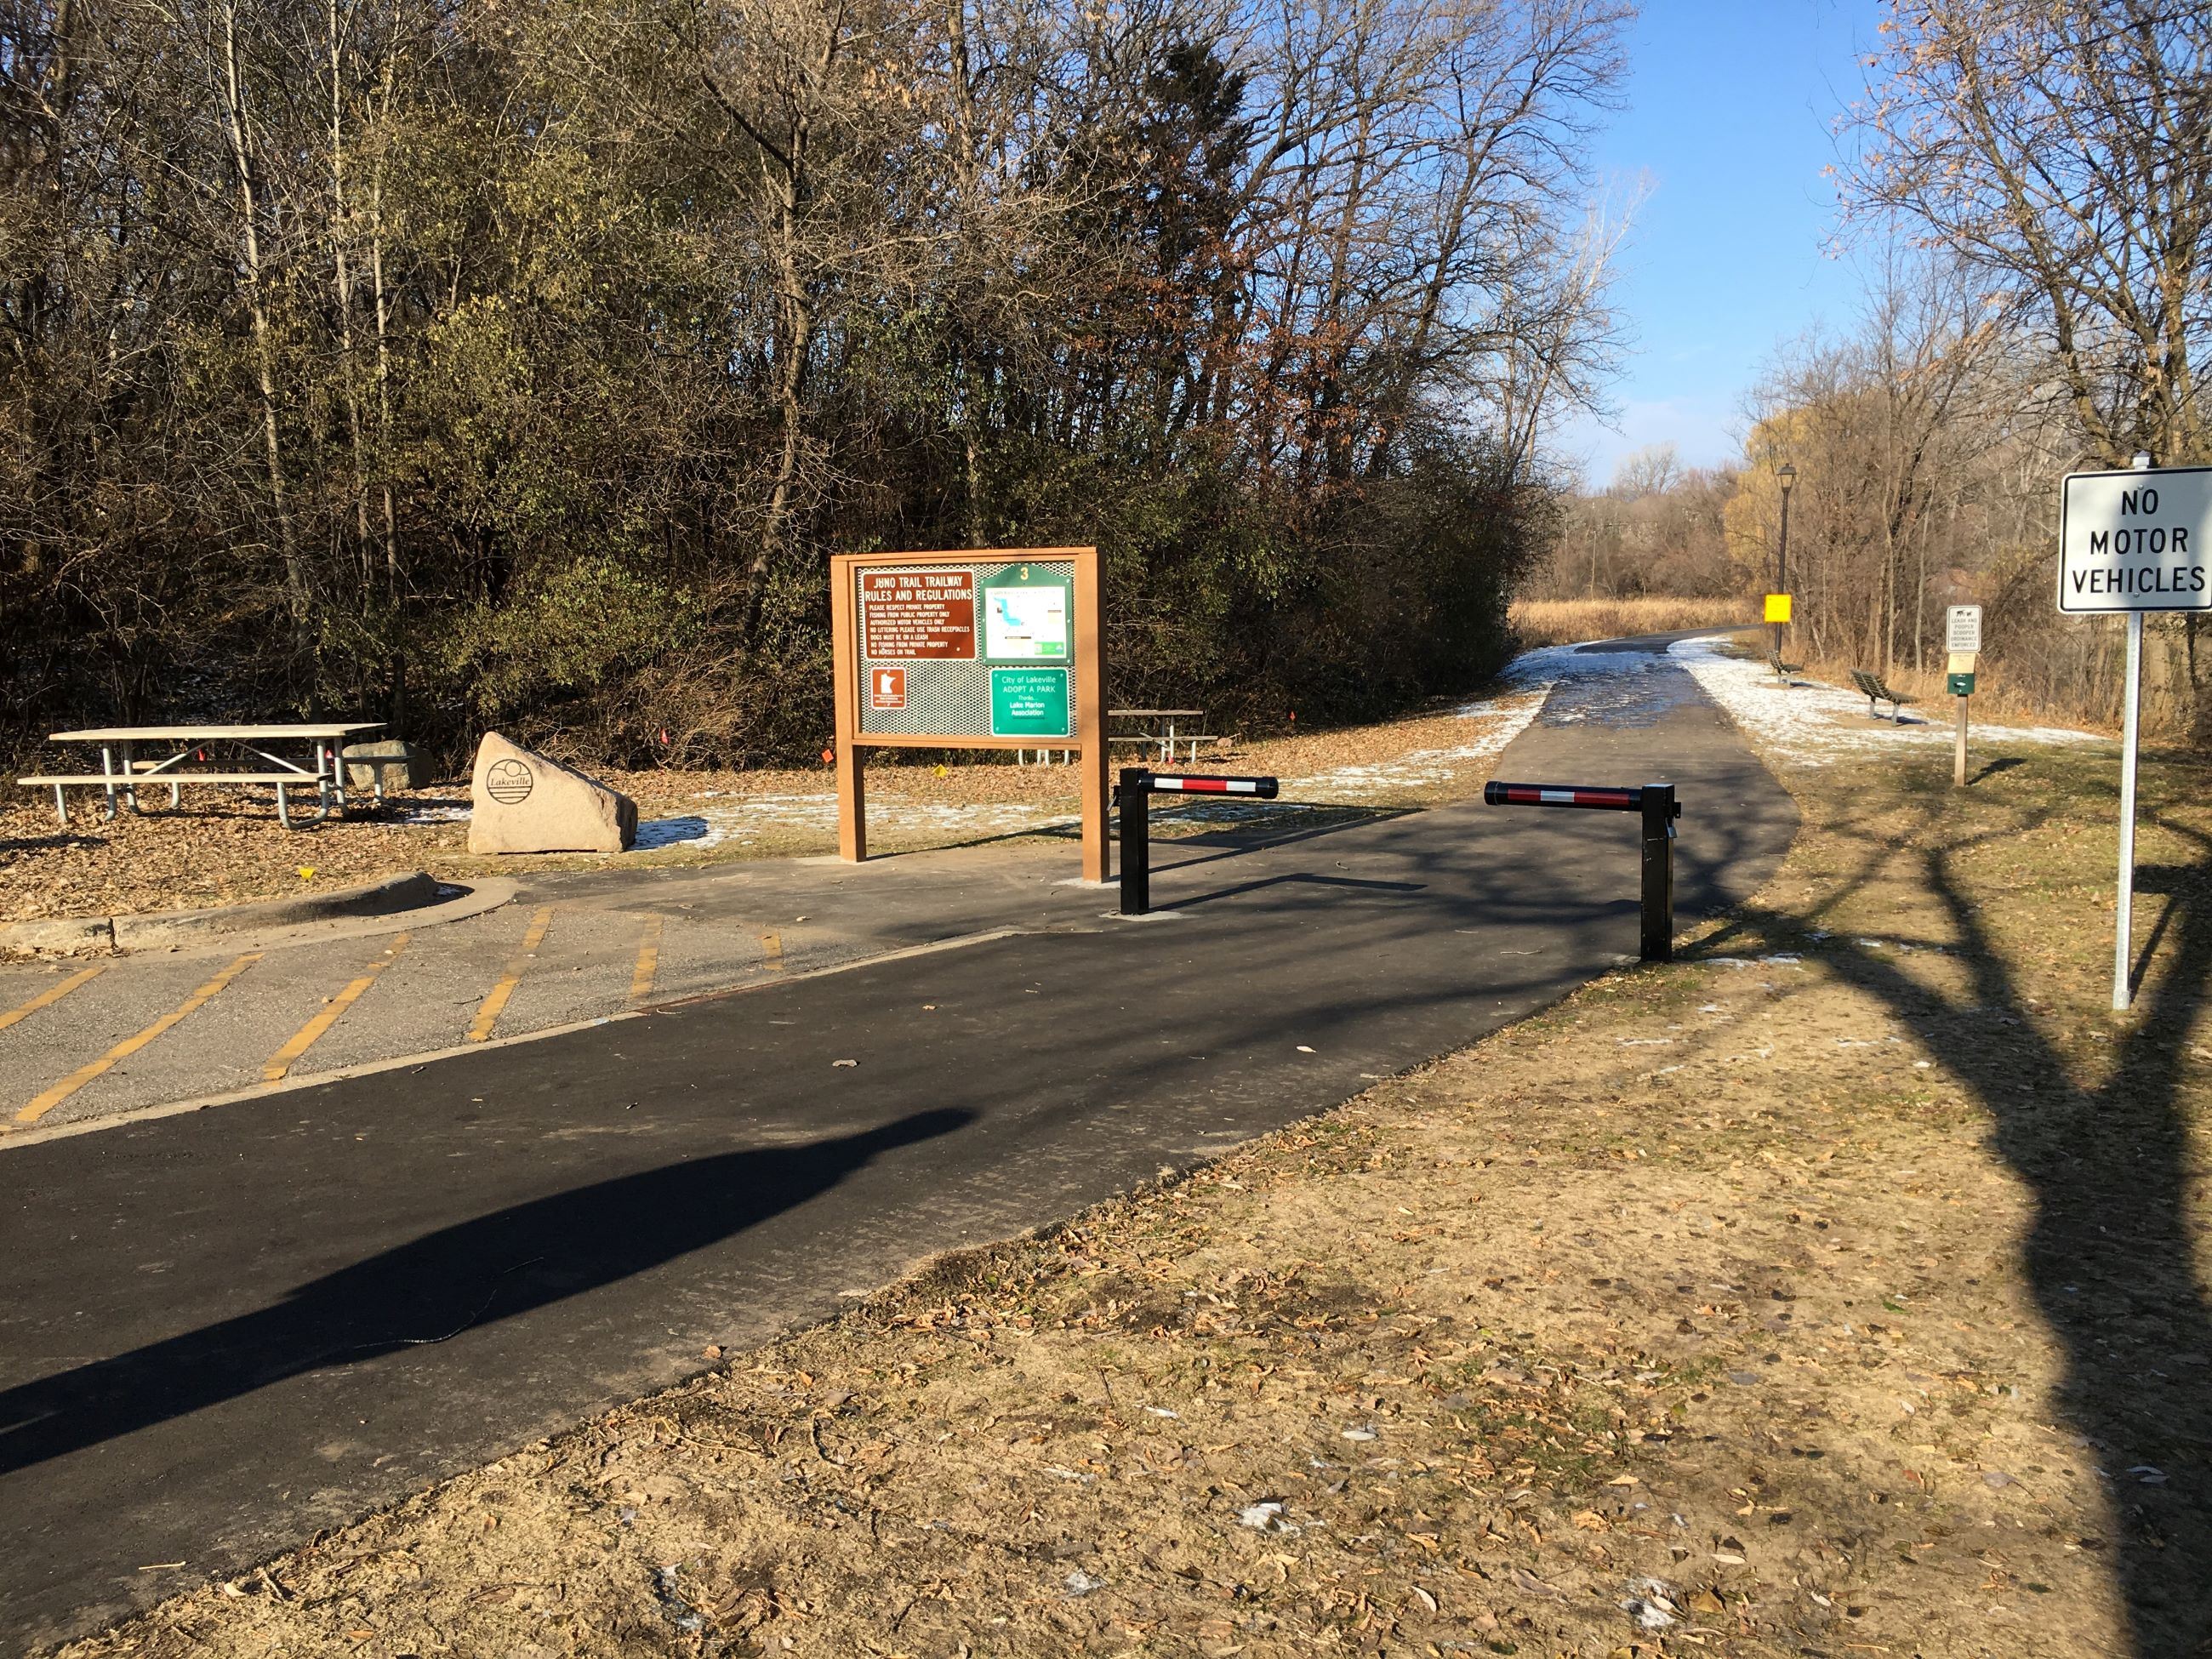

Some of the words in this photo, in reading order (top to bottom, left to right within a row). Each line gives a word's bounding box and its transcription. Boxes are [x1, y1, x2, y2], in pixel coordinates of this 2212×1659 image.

[2122, 489, 2158, 515] NO
[2090, 528, 2188, 554] MOTOR
[1020, 567, 1028, 580] 3
[2073, 566, 2205, 593] VEHICLES
[874, 578, 895, 588] JUNO
[899, 577, 922, 587] TRAIL
[925, 576, 963, 587] TRAILWAY
[865, 591, 892, 601] RULES
[896, 591, 912, 600] AND
[916, 589, 972, 600] REGULATIONS
[491, 778, 530, 786] Lakeville
